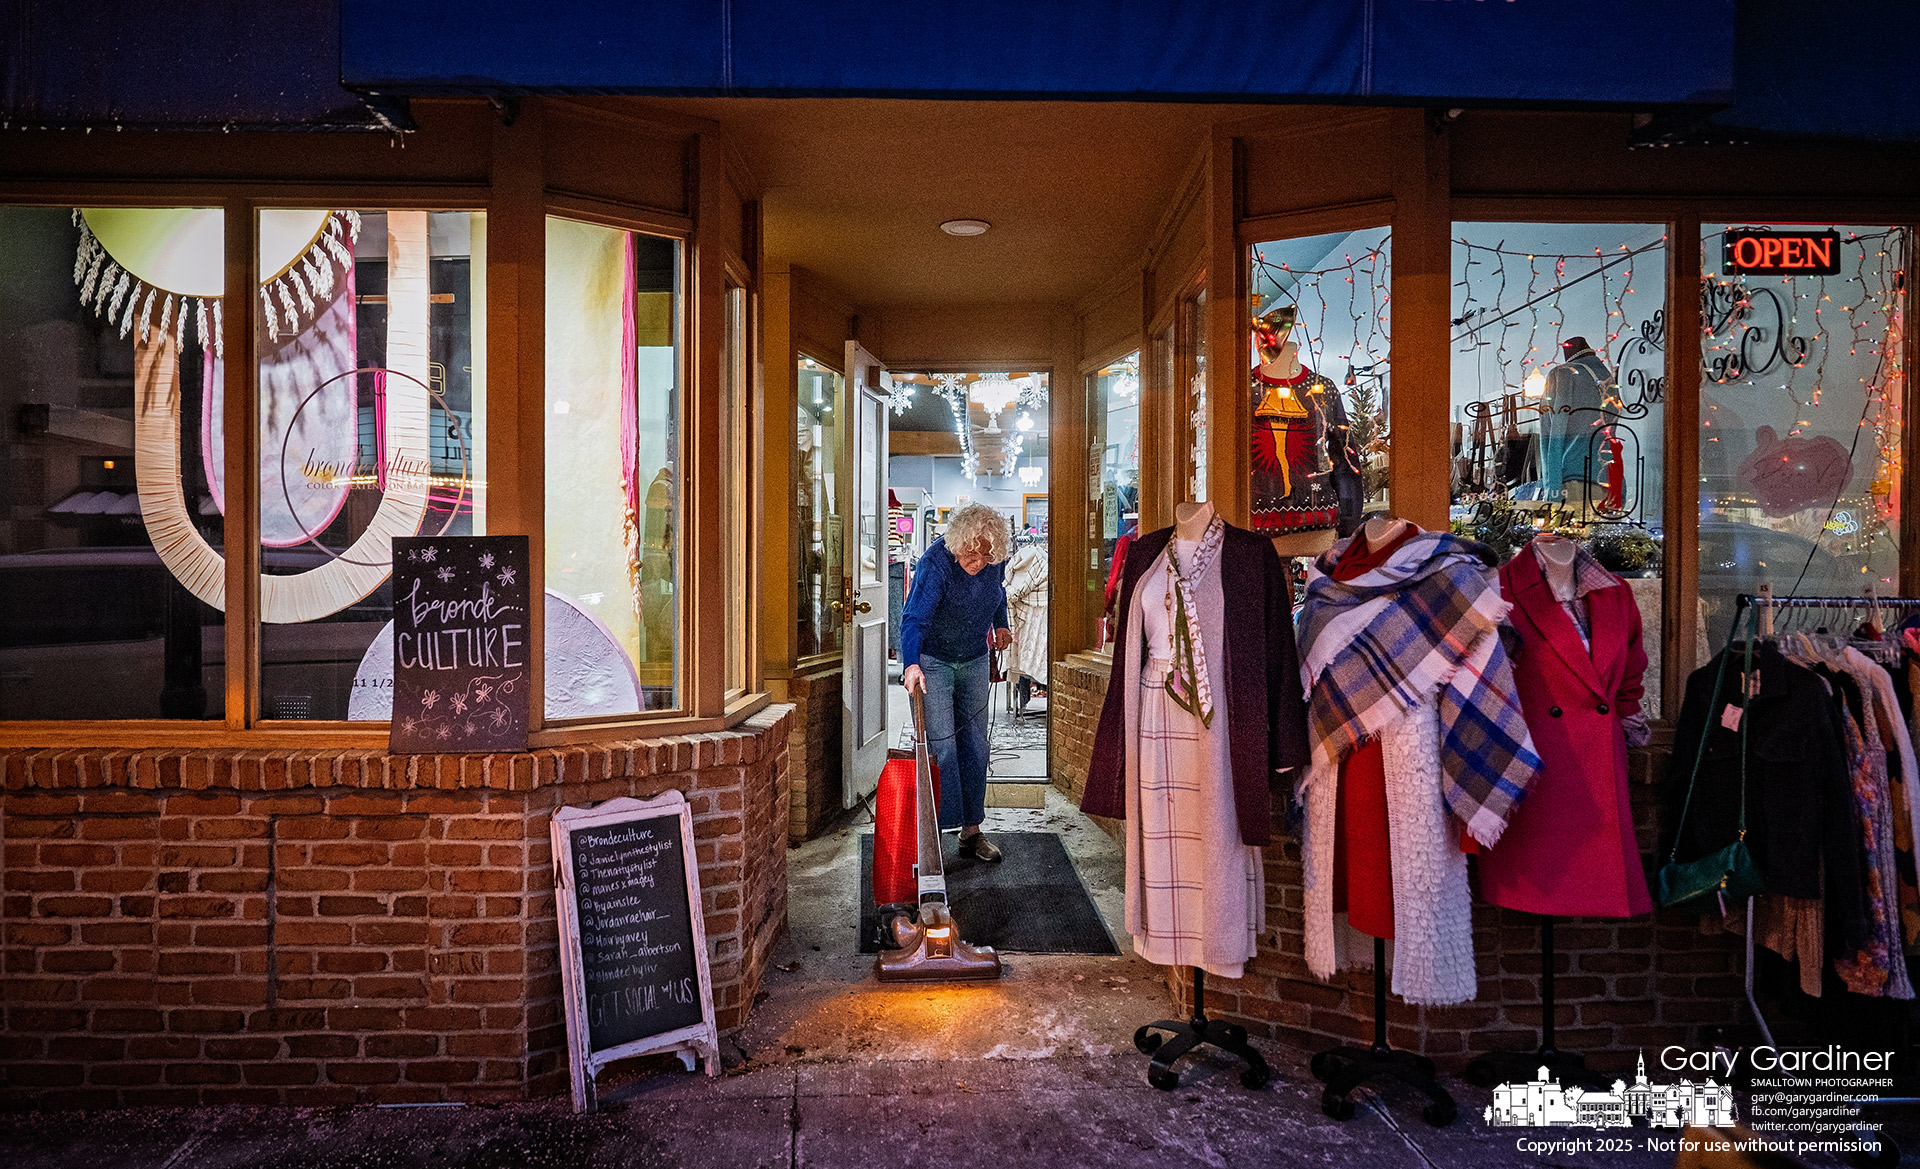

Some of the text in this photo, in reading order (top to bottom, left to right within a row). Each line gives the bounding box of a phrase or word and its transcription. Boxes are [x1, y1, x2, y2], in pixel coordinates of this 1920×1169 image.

[1734, 237, 1833, 268] OPEN
[407, 482, 425, 490] BAR
[403, 578, 510, 628] bronde
[398, 624, 523, 671] CULTURE
[372, 678, 394, 690] 1/2
[590, 990, 621, 1027] GET
[625, 985, 659, 1016] SOCIAL
[674, 977, 693, 1004] US
